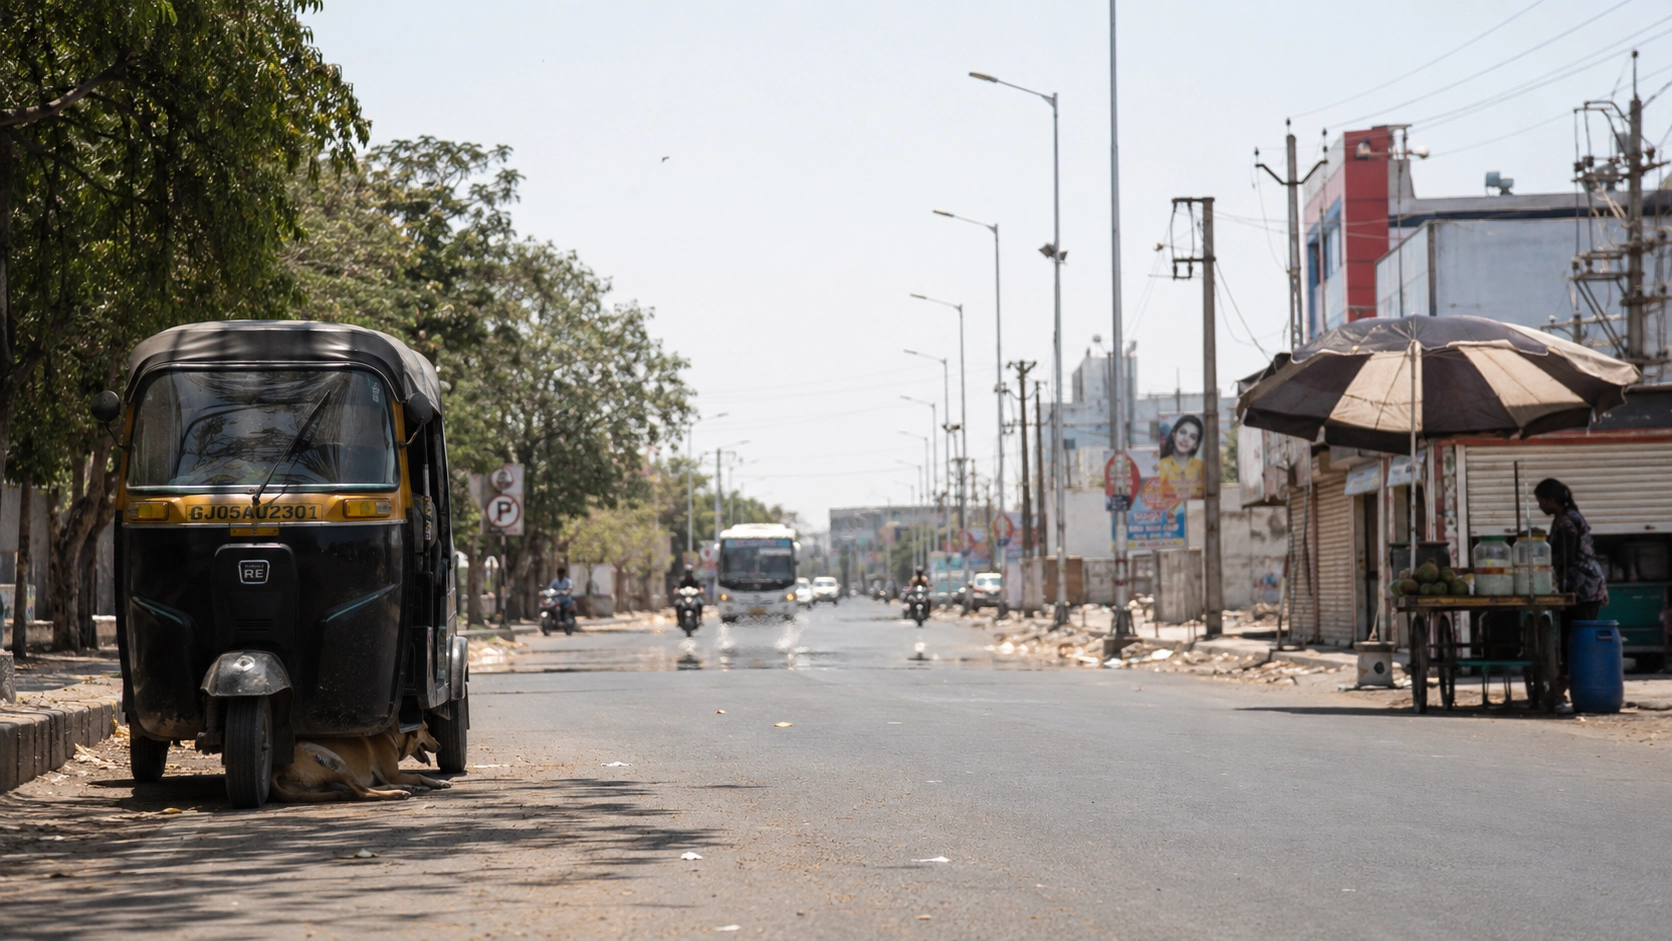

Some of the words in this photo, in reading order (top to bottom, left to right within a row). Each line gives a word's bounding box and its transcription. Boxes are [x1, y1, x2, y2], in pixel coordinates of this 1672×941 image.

[190, 505, 318, 520] GJ05AU2301
[497, 501, 512, 522] P
[244, 569, 264, 579] RE
